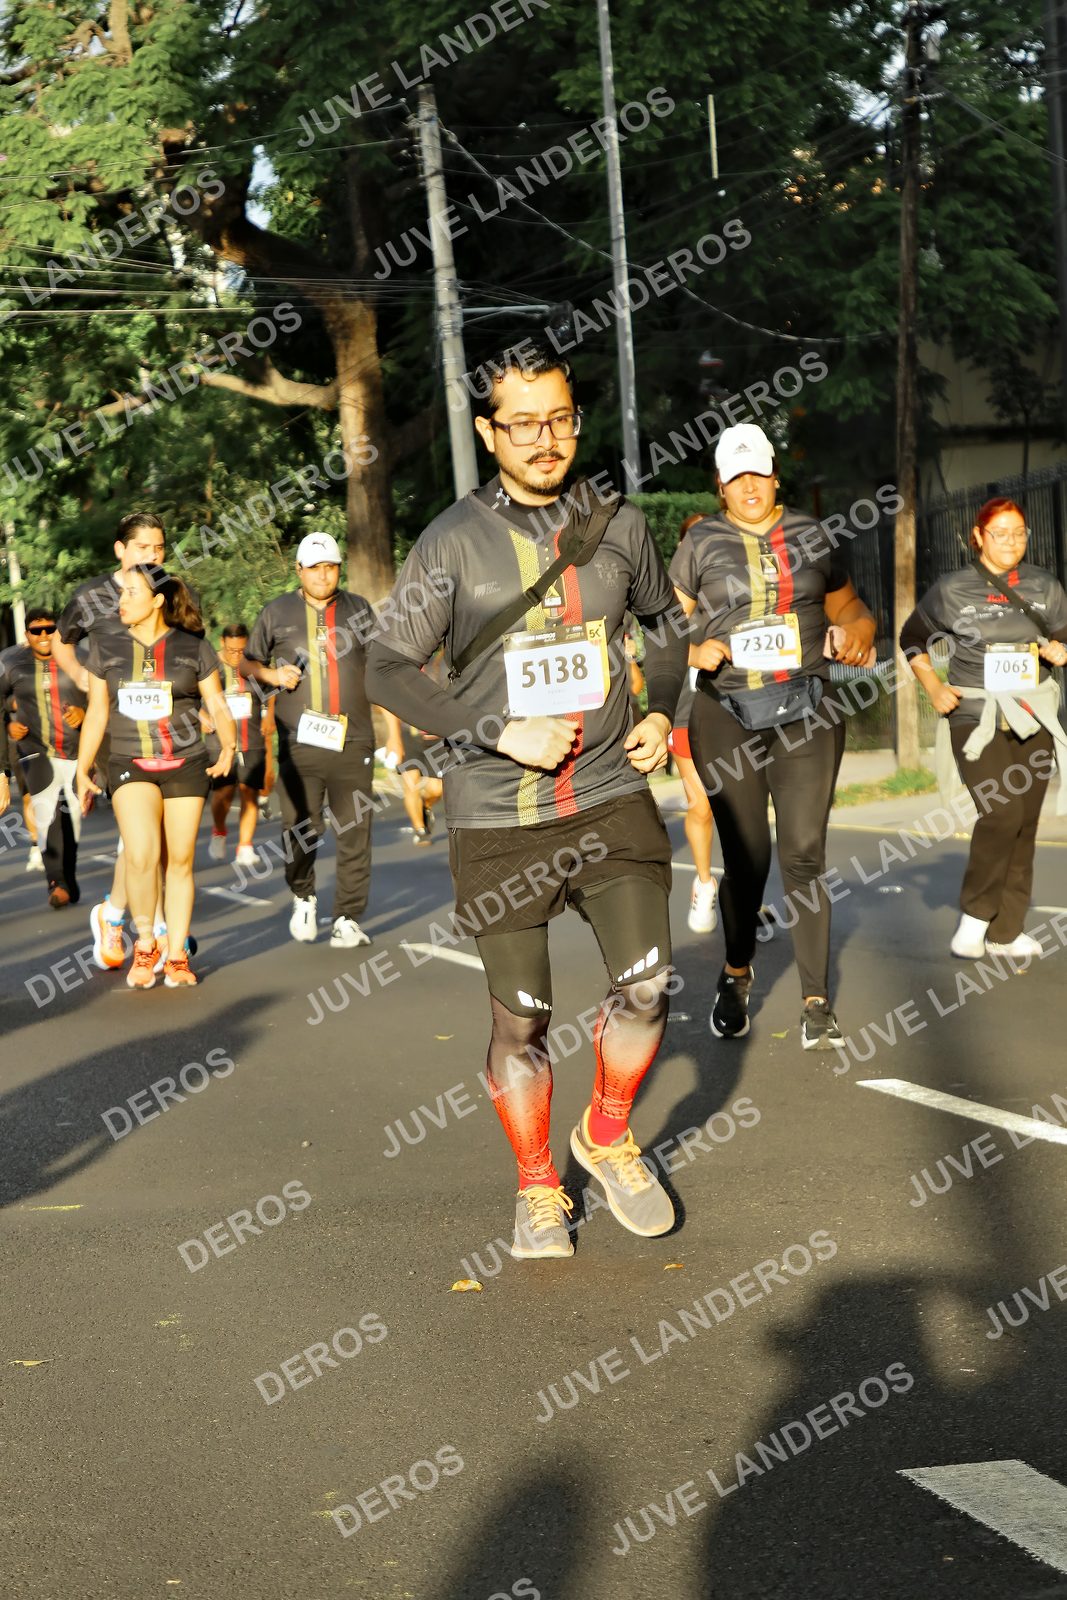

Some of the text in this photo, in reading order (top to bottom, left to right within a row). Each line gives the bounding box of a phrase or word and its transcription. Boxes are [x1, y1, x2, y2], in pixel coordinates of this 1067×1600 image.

[740, 633, 785, 651] 7320
[521, 653, 588, 688] 5138
[994, 659, 1029, 673] 7065
[127, 694, 161, 705] 1494
[306, 720, 336, 736] 7407
